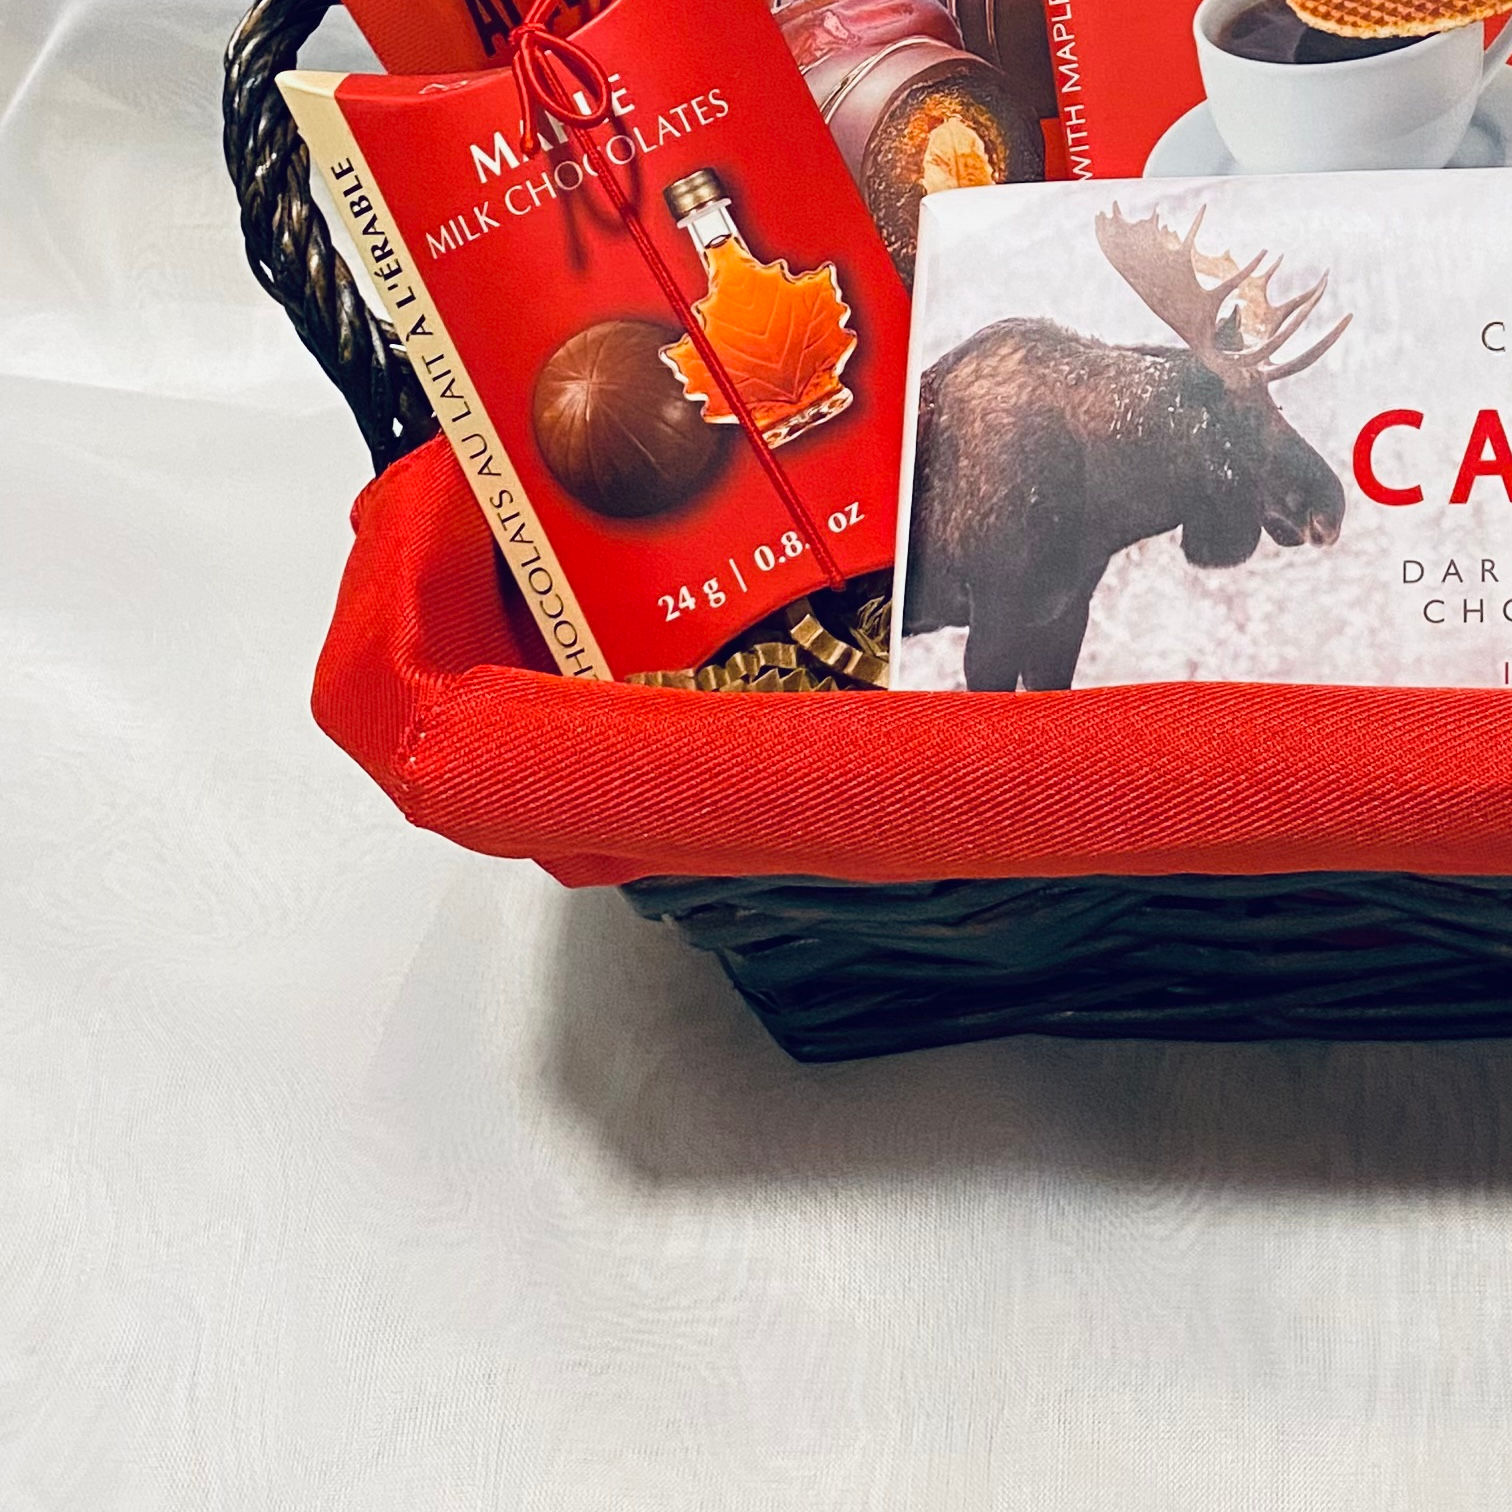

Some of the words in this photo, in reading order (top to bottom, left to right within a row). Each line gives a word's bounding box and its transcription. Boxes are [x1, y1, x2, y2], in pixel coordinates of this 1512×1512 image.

[1064, 104, 1093, 182] WITH
[330, 157, 417, 308] L'ÉRABLE
[425, 201, 501, 259] MILK
[405, 313, 434, 342] À
[422, 354, 472, 423] LAIT
[461, 433, 502, 477] AU
[488, 489, 600, 682] HOCOLATS
[657, 585, 696, 622] 24
[702, 576, 727, 609] g
[753, 530, 811, 572] 0.8
[827, 501, 866, 534] oz
